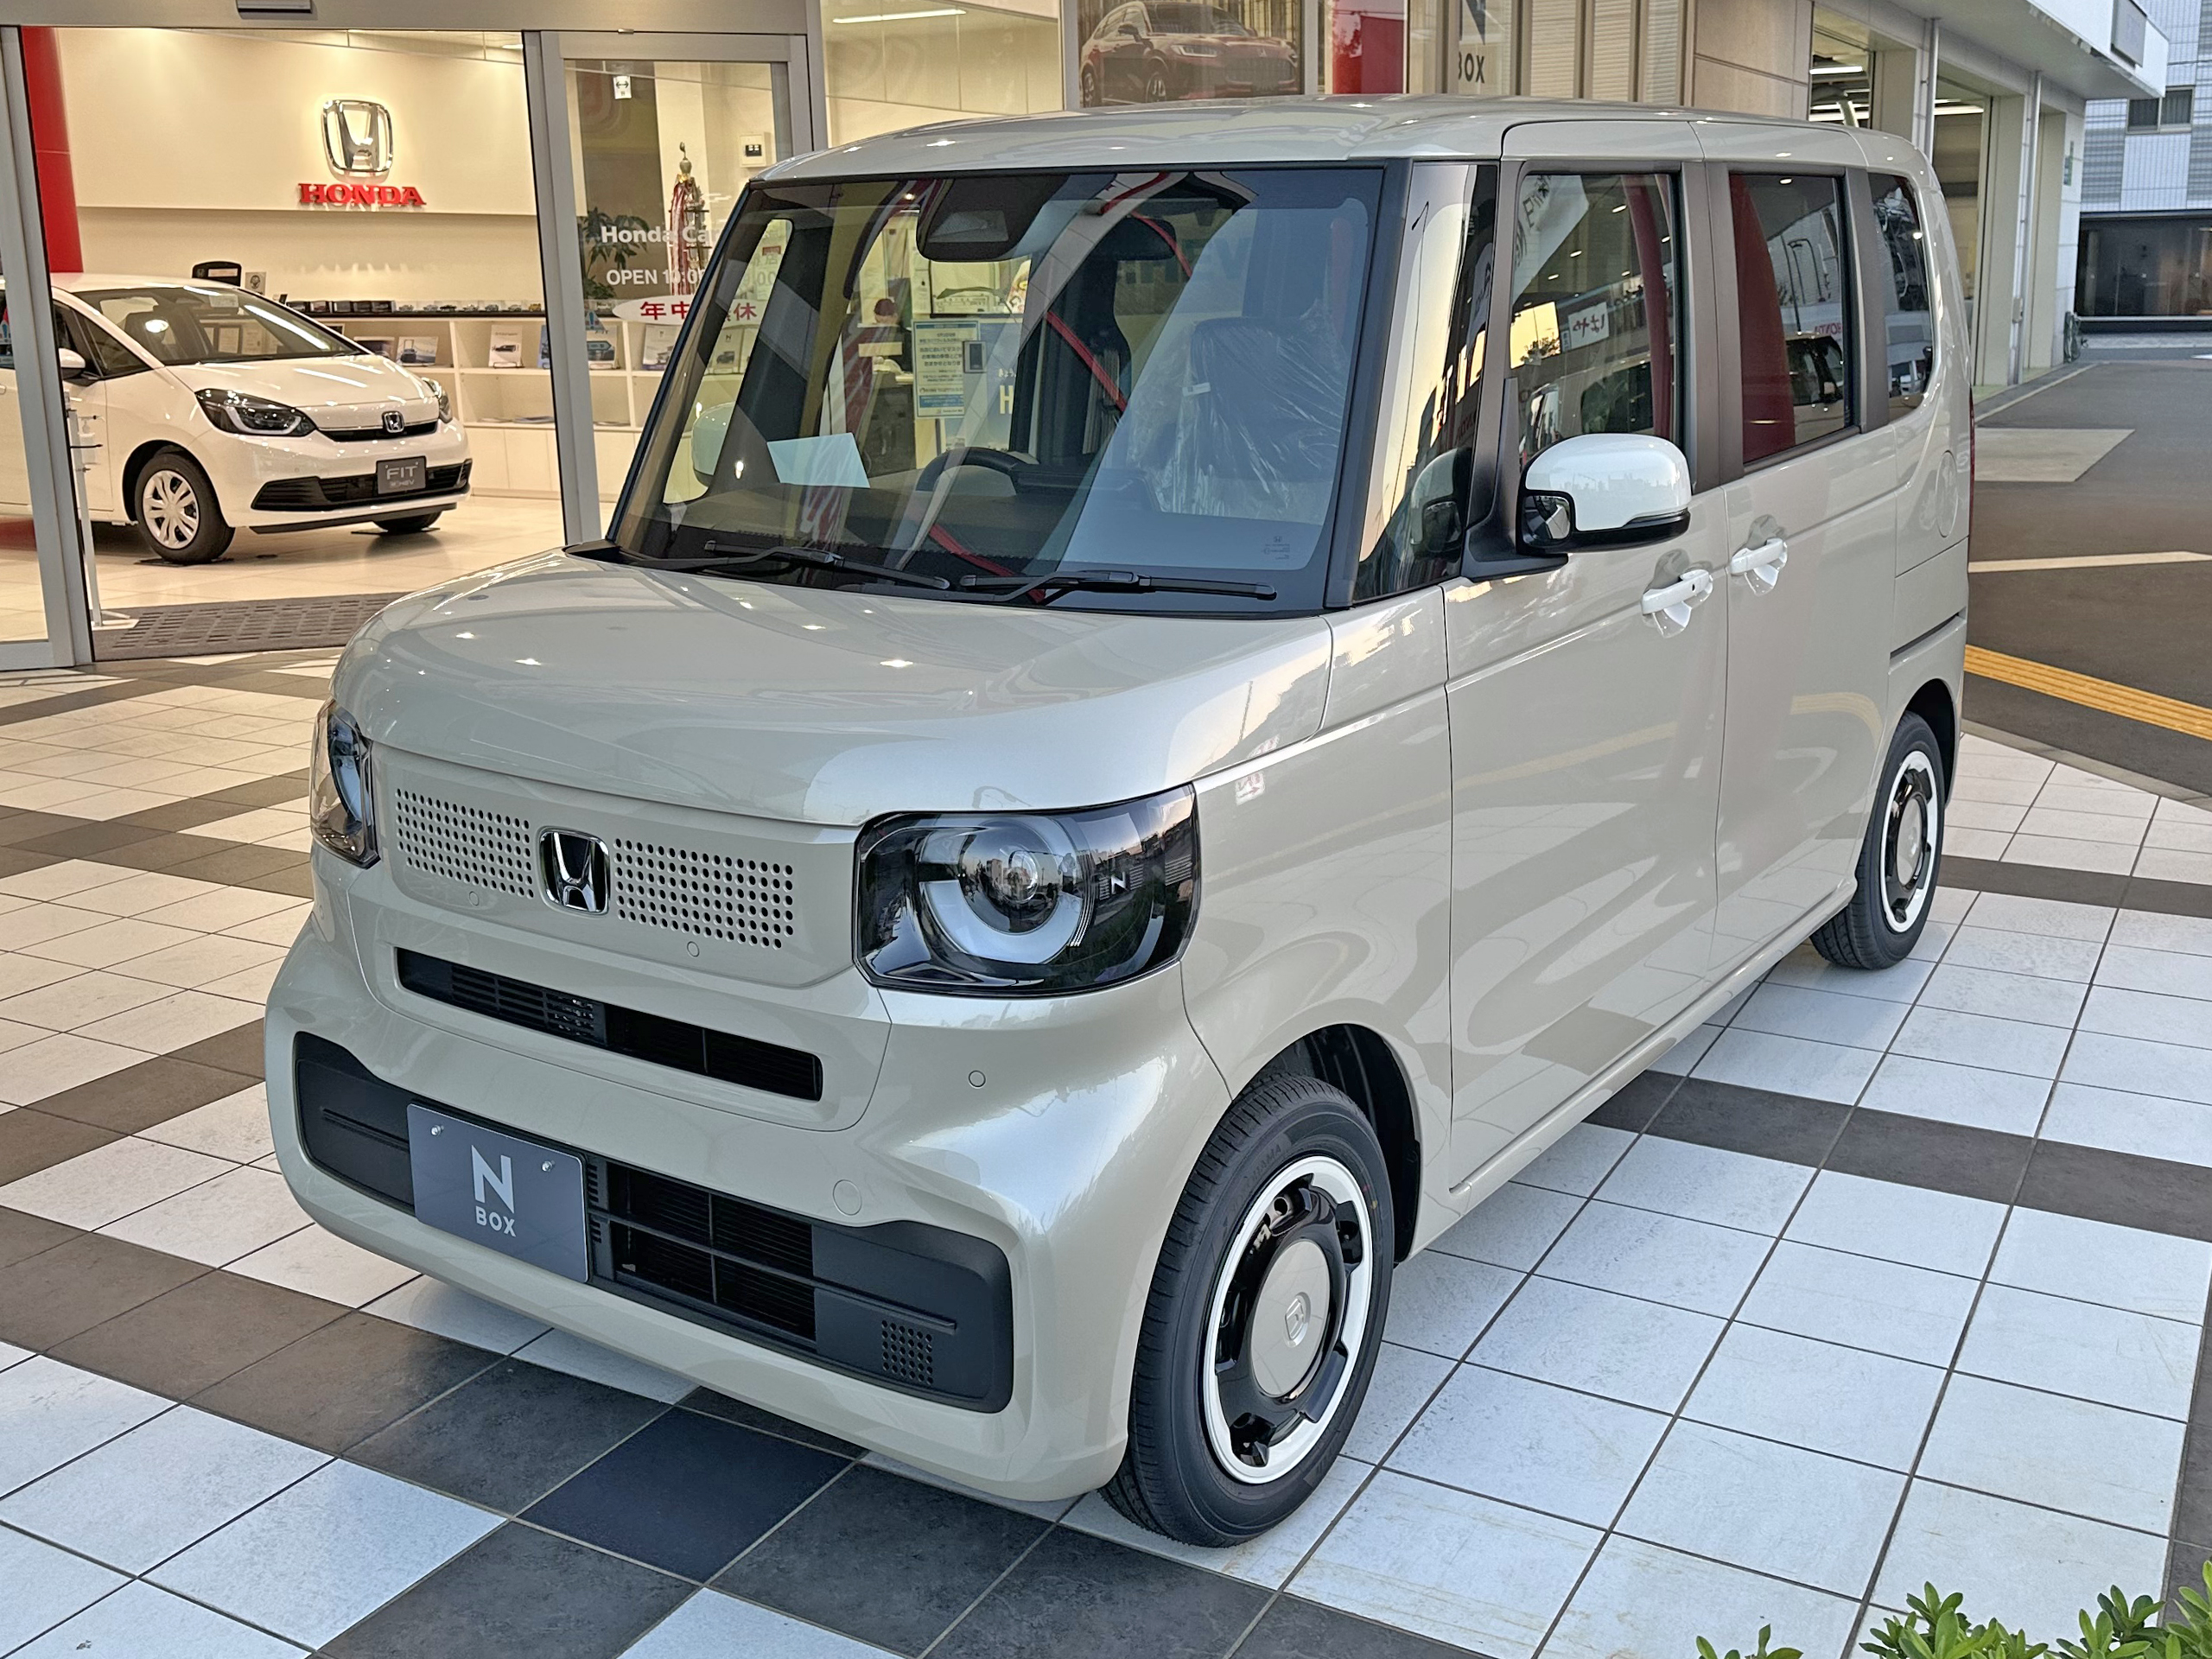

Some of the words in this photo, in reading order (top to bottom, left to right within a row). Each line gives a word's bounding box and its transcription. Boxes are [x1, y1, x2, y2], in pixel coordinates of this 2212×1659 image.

[298, 182, 426, 207] HONDA
[601, 226, 675, 243] Honda
[607, 270, 658, 285] OPEN
[386, 466, 417, 480] FIT
[471, 1144, 515, 1214] N
[474, 1205, 517, 1237] BOX
